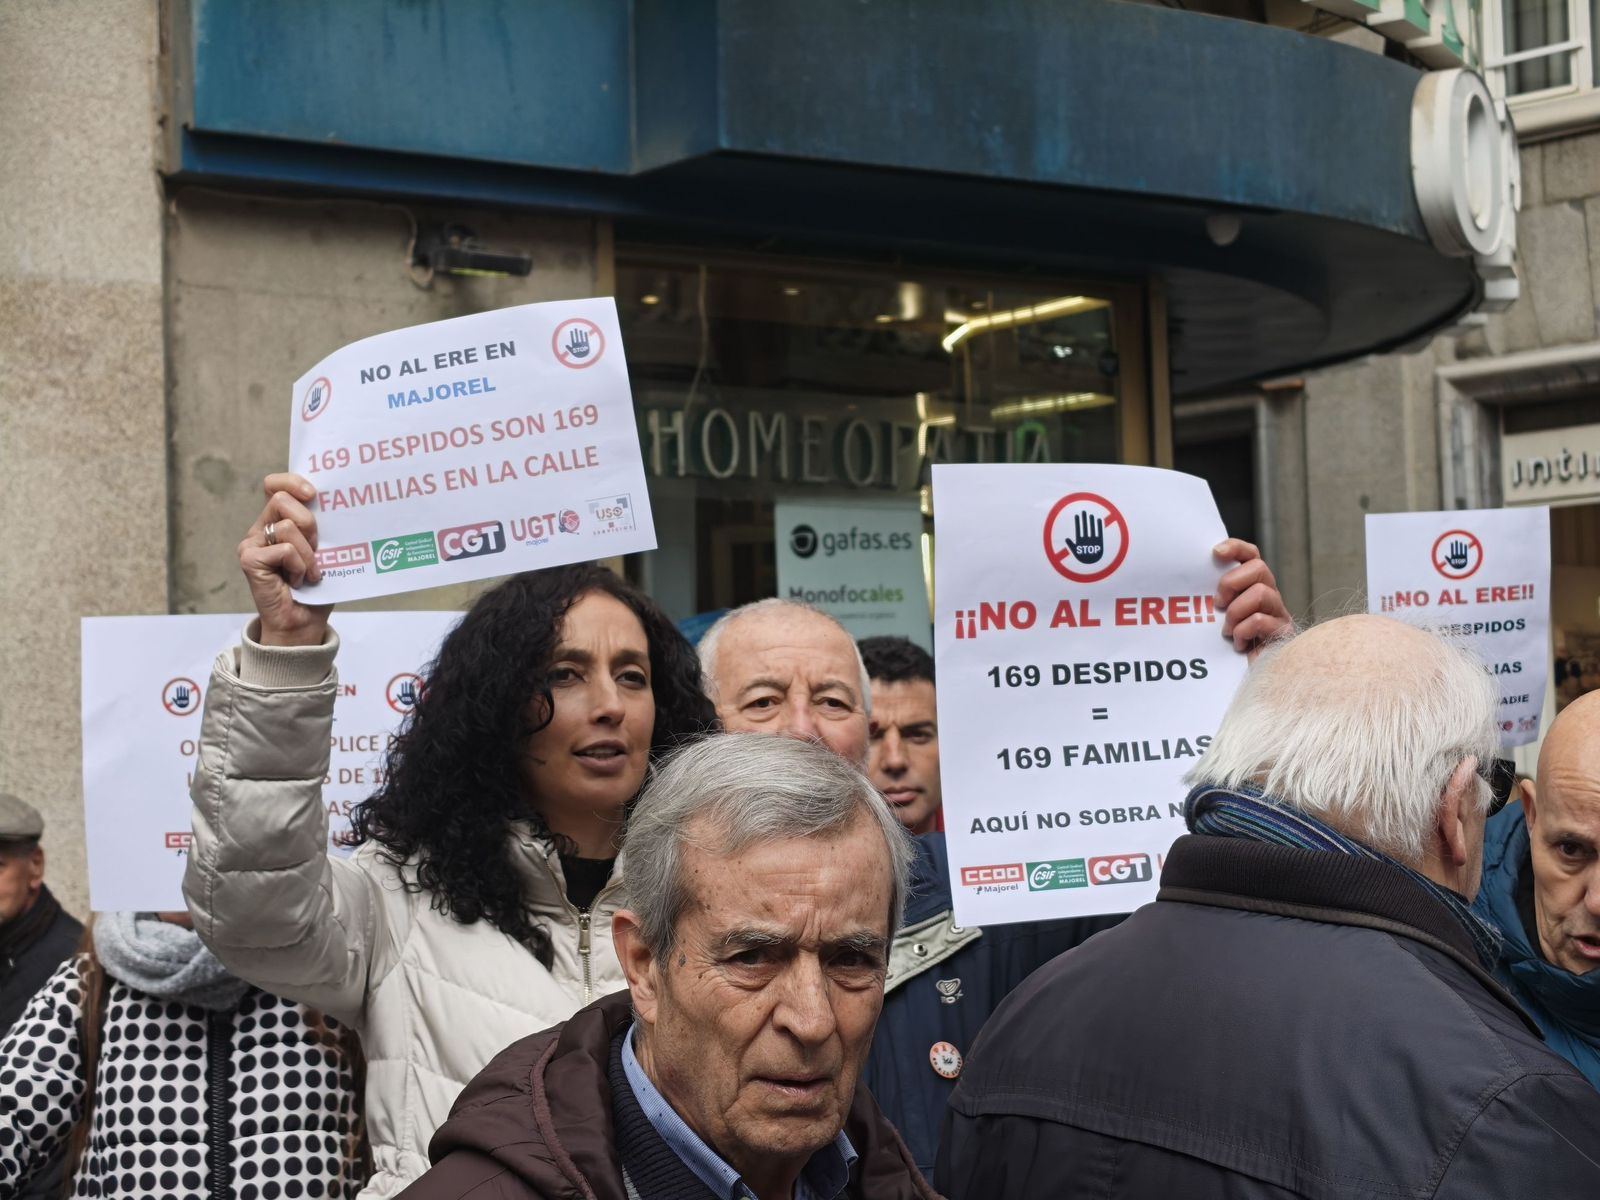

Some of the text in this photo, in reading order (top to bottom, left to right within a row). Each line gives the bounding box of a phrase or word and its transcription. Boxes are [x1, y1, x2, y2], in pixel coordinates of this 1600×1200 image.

[360, 341, 516, 384] NO AL ERE EN
[387, 376, 496, 409] MAJOREL
[308, 404, 599, 473] 169 DESPIDOS SON 169
[318, 445, 599, 512] FAMILIAS EN LA CALLE
[510, 513, 556, 541] UGT
[596, 506, 623, 520] USO
[443, 525, 500, 557] CGT
[822, 525, 913, 559] gafas.es
[1076, 544, 1100, 555] STOP
[328, 566, 365, 578] Majorel
[789, 584, 904, 603] Monofocales
[1438, 589, 1468, 606] AL
[1476, 583, 1535, 604] ERE!!
[955, 595, 1216, 639] ¡¡NO AL ERE!!
[988, 658, 1208, 688] 169 DESPIDOS
[1500, 694, 1529, 705] ADIE
[997, 735, 1213, 770] 169 FAMILIAS
[339, 768, 364, 784] DE
[970, 811, 1028, 834] AQUÍ
[1037, 811, 1071, 830] NO
[1079, 804, 1160, 827] SOBRA
[965, 866, 1020, 883] CCOO
[1093, 857, 1147, 881] CGT
[984, 883, 1019, 893] Majorel
